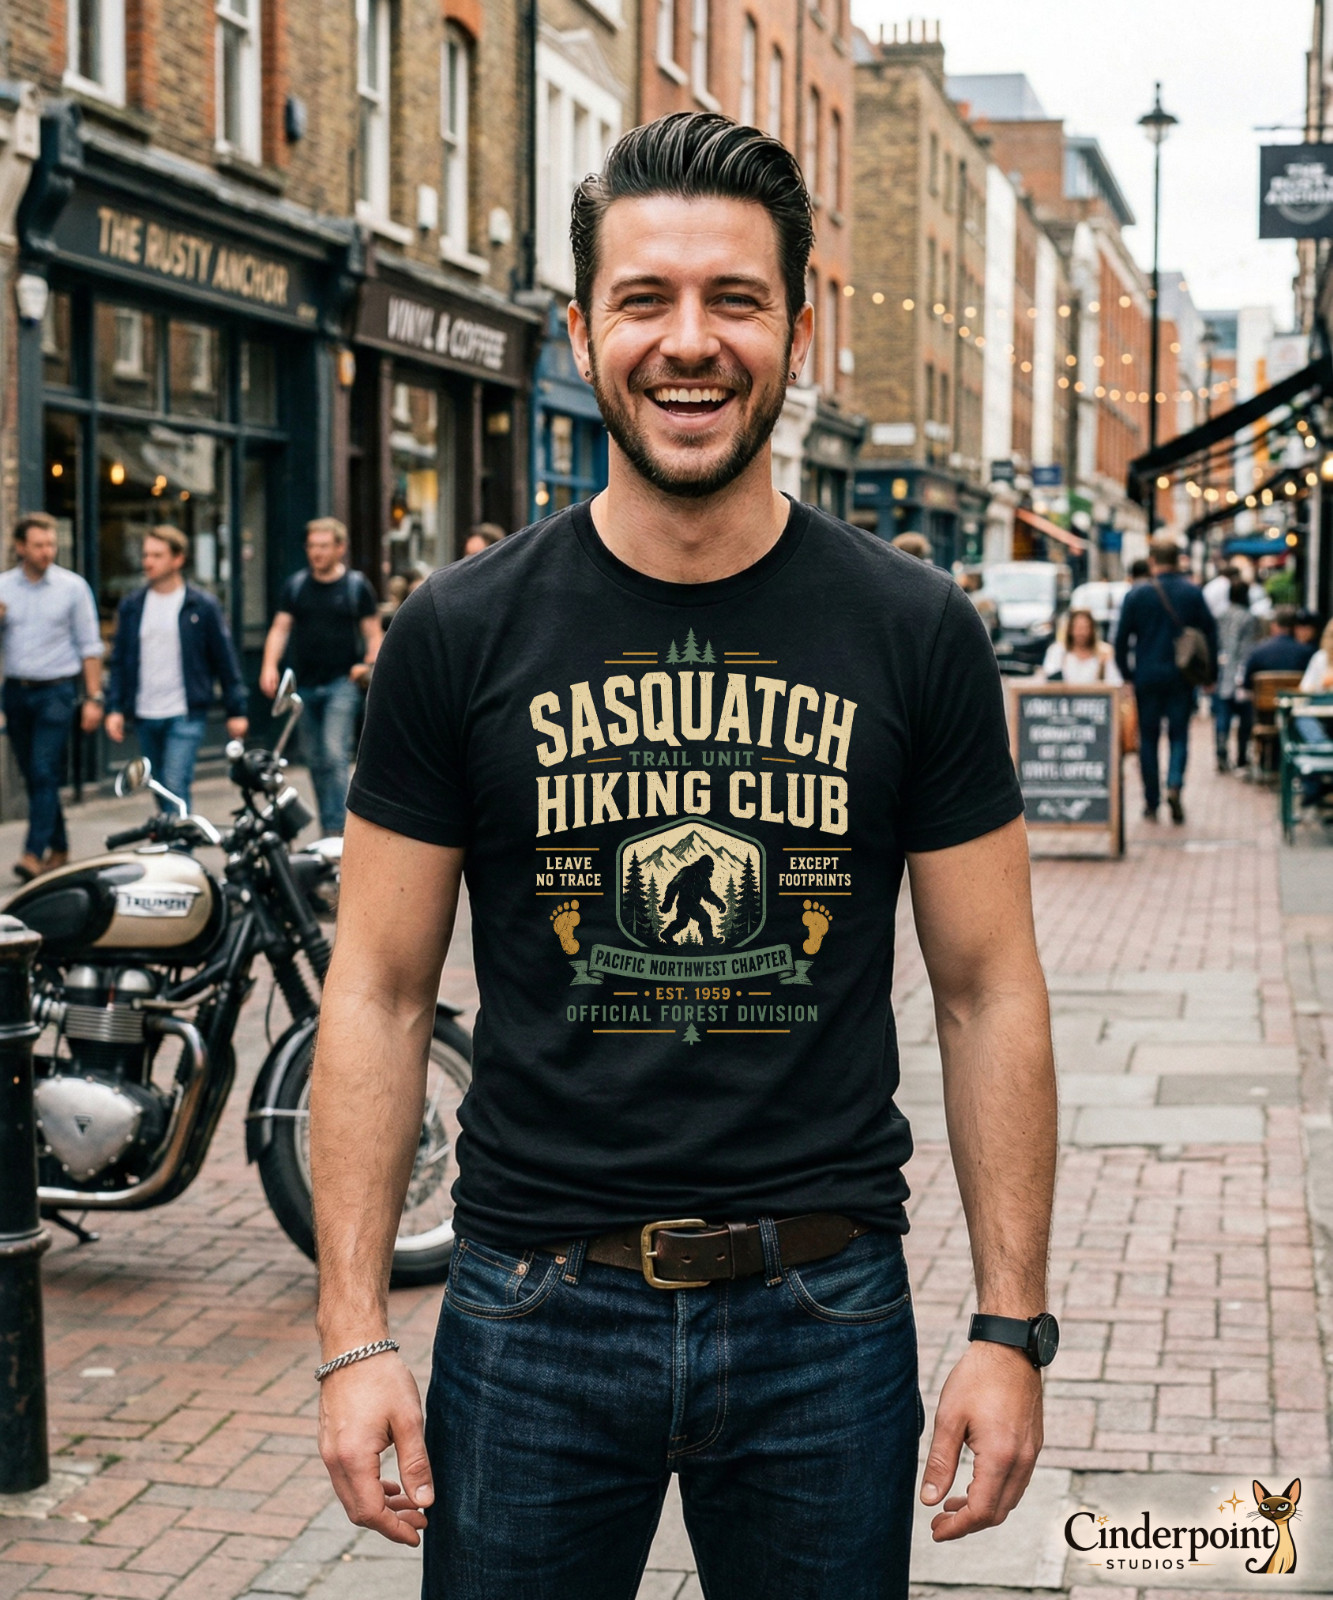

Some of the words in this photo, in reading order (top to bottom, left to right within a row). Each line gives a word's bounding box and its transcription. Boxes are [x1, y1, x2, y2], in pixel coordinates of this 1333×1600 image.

[97, 206, 142, 264] THE
[144, 221, 213, 284] RUSTY
[211, 246, 289, 307] ANCHOR
[387, 296, 435, 351] VINYL
[449, 318, 507, 370] COFFEE
[529, 671, 857, 772] SASQUATCH
[629, 751, 692, 767] TRAIL
[702, 751, 754, 767] UNIT
[536, 771, 711, 837] HIKING
[729, 771, 849, 836] CLUB
[546, 857, 592, 870] LEAVE
[790, 857, 839, 870] EXCEPT
[536, 873, 554, 886] NO
[560, 873, 602, 886] TRACE
[779, 873, 852, 886] FOOTPRINTS
[126, 896, 187, 910] TRIUMPH
[595, 950, 645, 974] PACIFIC
[650, 959, 727, 977] NORTHWEST
[731, 950, 787, 974] CHAPTER
[656, 987, 688, 1000] EST.
[694, 987, 731, 1000] 1959
[566, 1004, 652, 1022] OFFICIAL
[660, 1004, 729, 1022] FOREST
[737, 1004, 819, 1022] DIVISION
